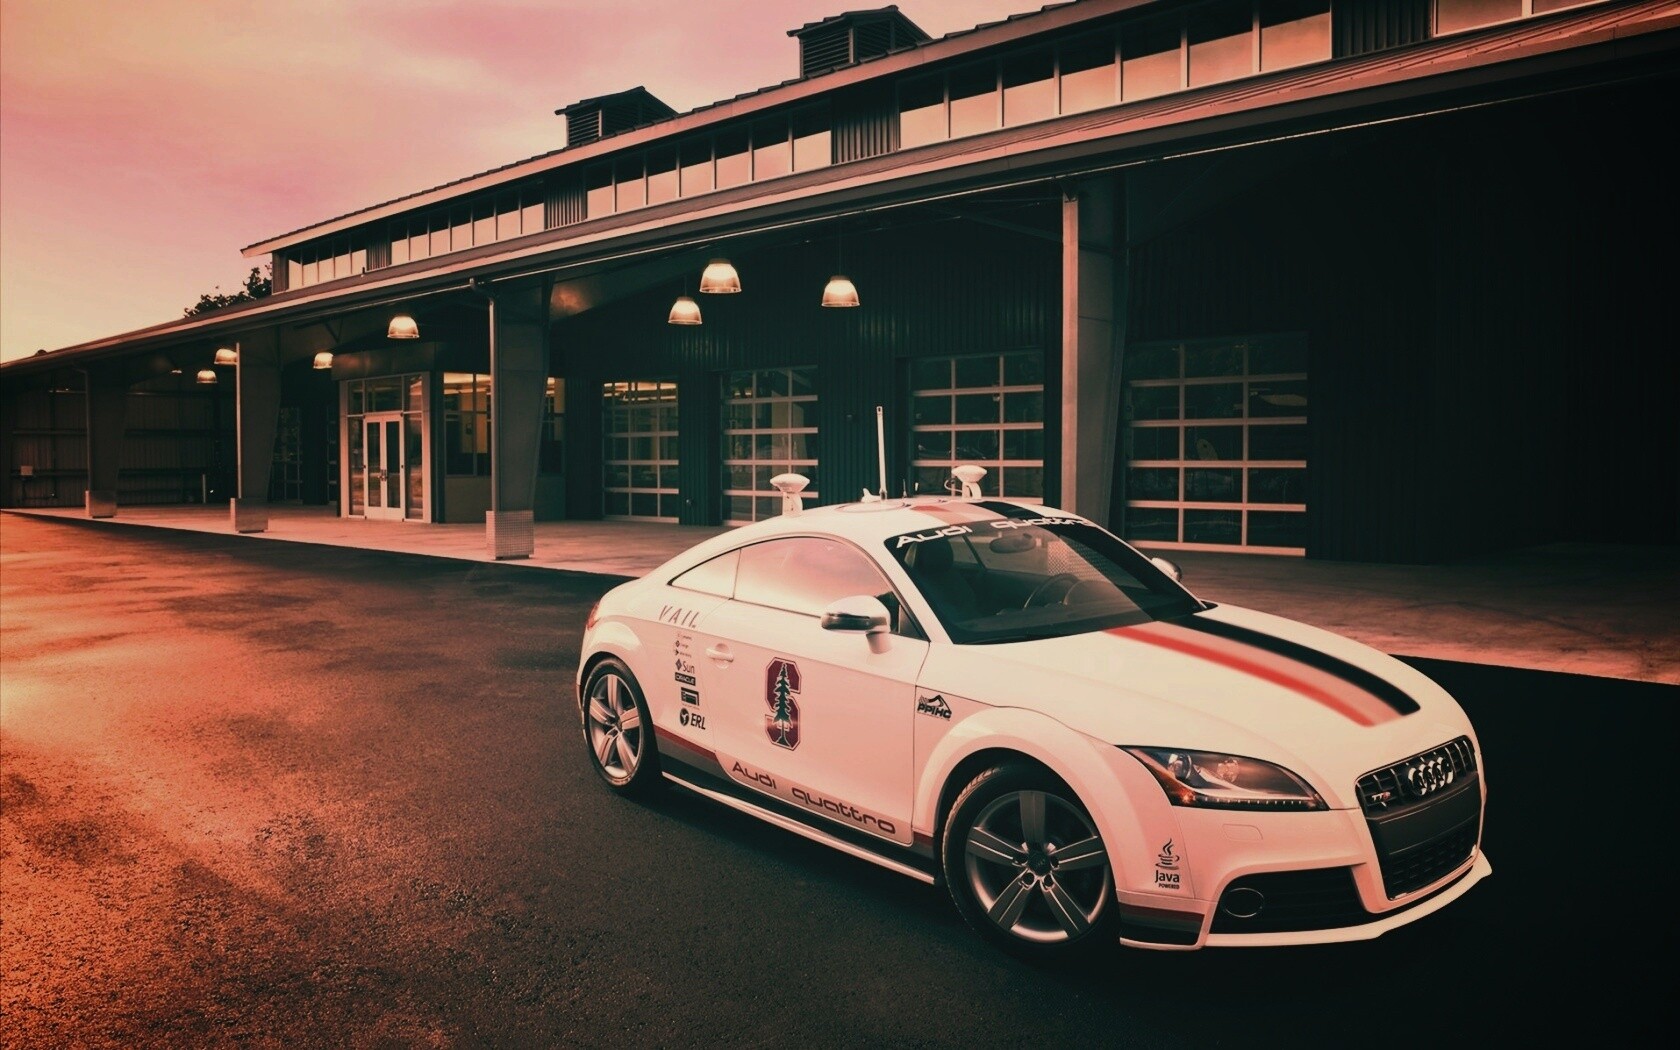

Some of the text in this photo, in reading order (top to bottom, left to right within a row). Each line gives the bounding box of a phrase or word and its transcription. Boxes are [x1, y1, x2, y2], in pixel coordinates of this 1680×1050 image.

[659, 605, 699, 628] VAIL
[682, 661, 695, 675] Sun
[676, 673, 695, 686] ORACLE
[690, 713, 706, 730] ERL
[732, 761, 896, 835] Audi quattro
[1155, 870, 1180, 884] Java
